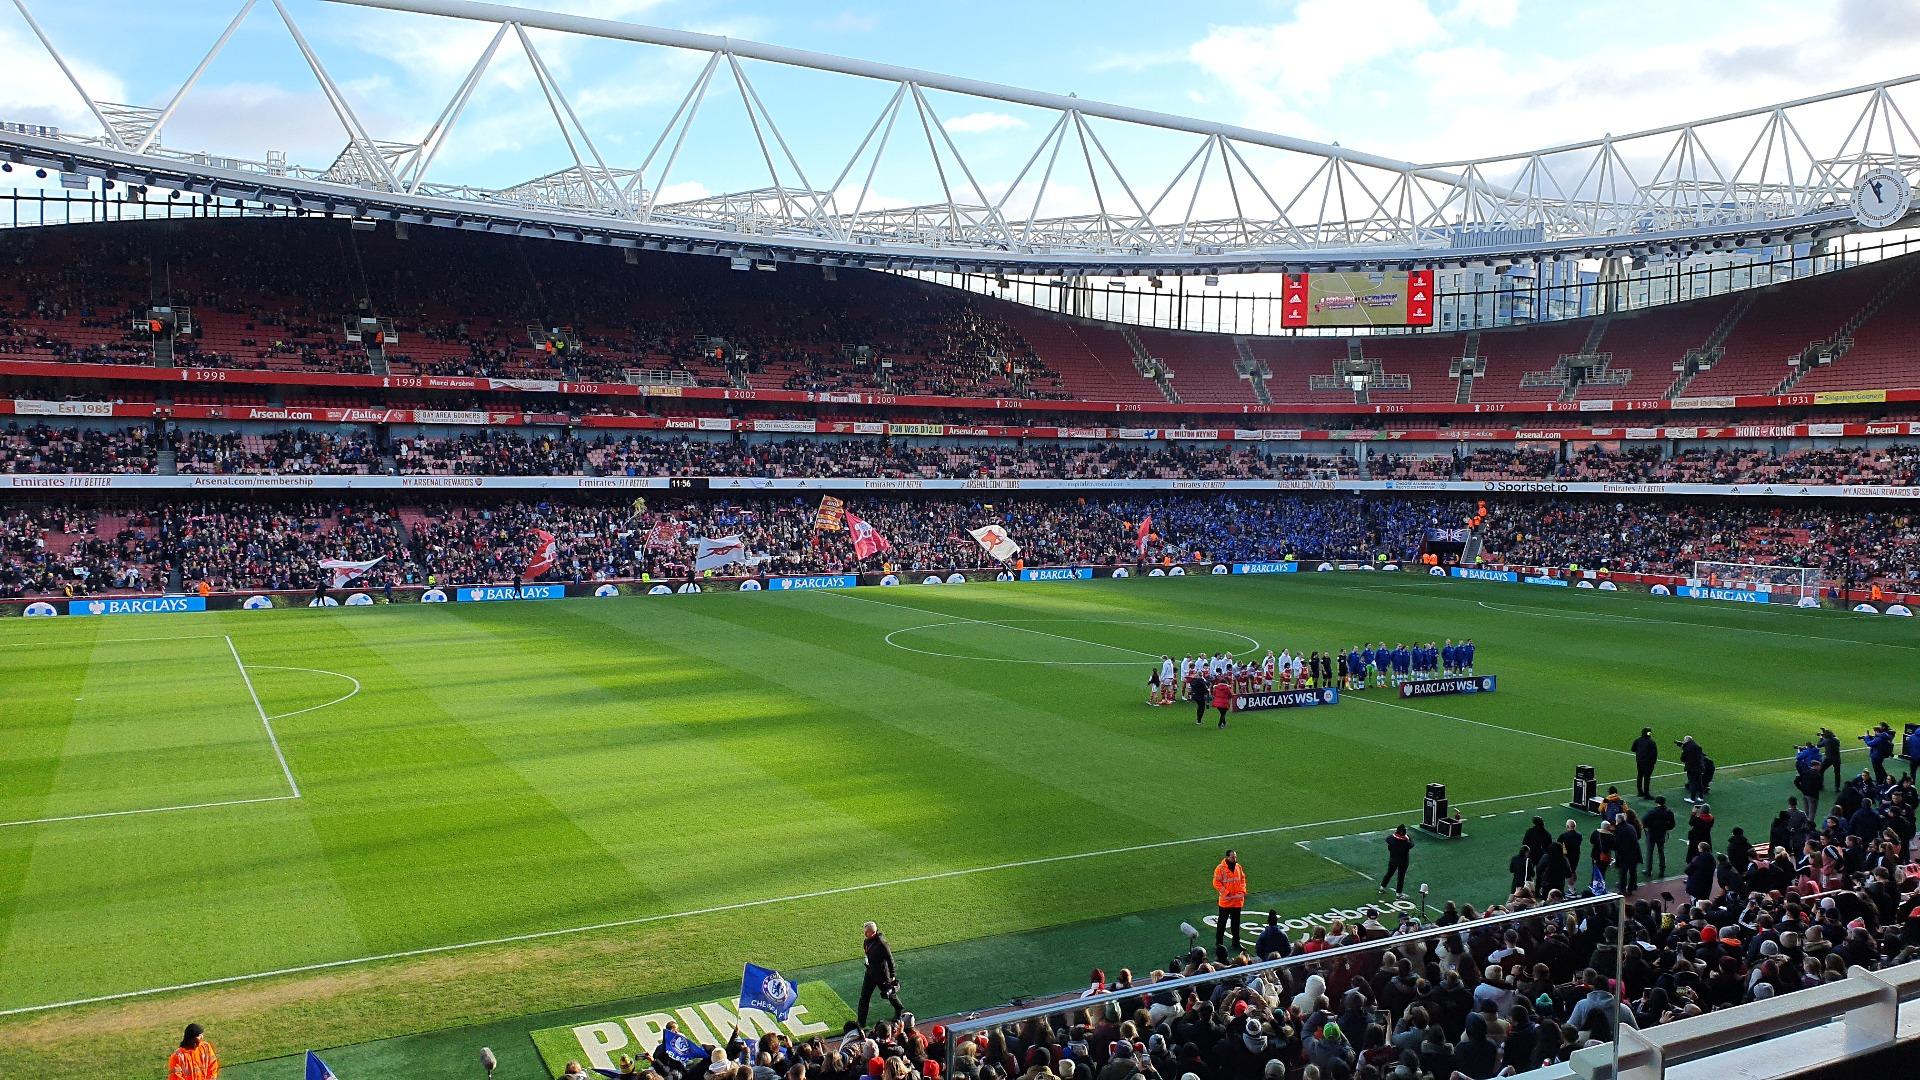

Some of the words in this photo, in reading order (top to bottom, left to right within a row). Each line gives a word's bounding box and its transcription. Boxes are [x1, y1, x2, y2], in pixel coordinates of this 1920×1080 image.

[196, 371, 226, 380] 1998
[396, 378, 422, 387] 1998
[429, 379, 450, 387] Merci
[574, 384, 598, 393] 2002
[734, 391, 756, 399] 2002
[1004, 400, 1022, 408] 2004
[1787, 396, 1809, 404] 1931
[82, 404, 110, 414] 1985
[1637, 401, 1658, 409] 1930
[249, 409, 312, 420] Arsenal.com
[665, 419, 696, 429] Arsenal
[948, 427, 989, 436] Arsenal.com
[1174, 430, 1195, 438] MILTON
[1737, 426, 1760, 437] HONG
[1770, 426, 1792, 437] KONG
[1865, 425, 1899, 434] Arsenal
[1515, 431, 1561, 440] Arsenal.com
[12, 477, 66, 487] Emirates
[69, 477, 83, 487] FLY
[84, 477, 112, 487] BETTER
[194, 477, 314, 487] Arsenal.com/membership
[402, 478, 412, 487] MY
[413, 478, 442, 487] ARSENAL
[443, 478, 474, 487] REWARDS
[578, 478, 617, 488] Emirates
[671, 479, 691, 489] 11:56
[1498, 482, 1568, 492] Sportsbet.io
[1603, 484, 1636, 492] Emirates
[1853, 487, 1880, 495] ARSENAL
[1881, 487, 1911, 496] REWARDS
[1251, 563, 1288, 573] BARCLAYS
[1469, 570, 1508, 582] BARCLAYS
[794, 578, 845, 589] BARCLAYS
[109, 599, 188, 613] BARCLAYS
[1414, 681, 1455, 694] BARCLAYS
[1456, 679, 1479, 691] WSL
[1248, 694, 1294, 707] BARCLAYS
[1295, 691, 1320, 704] WSL
